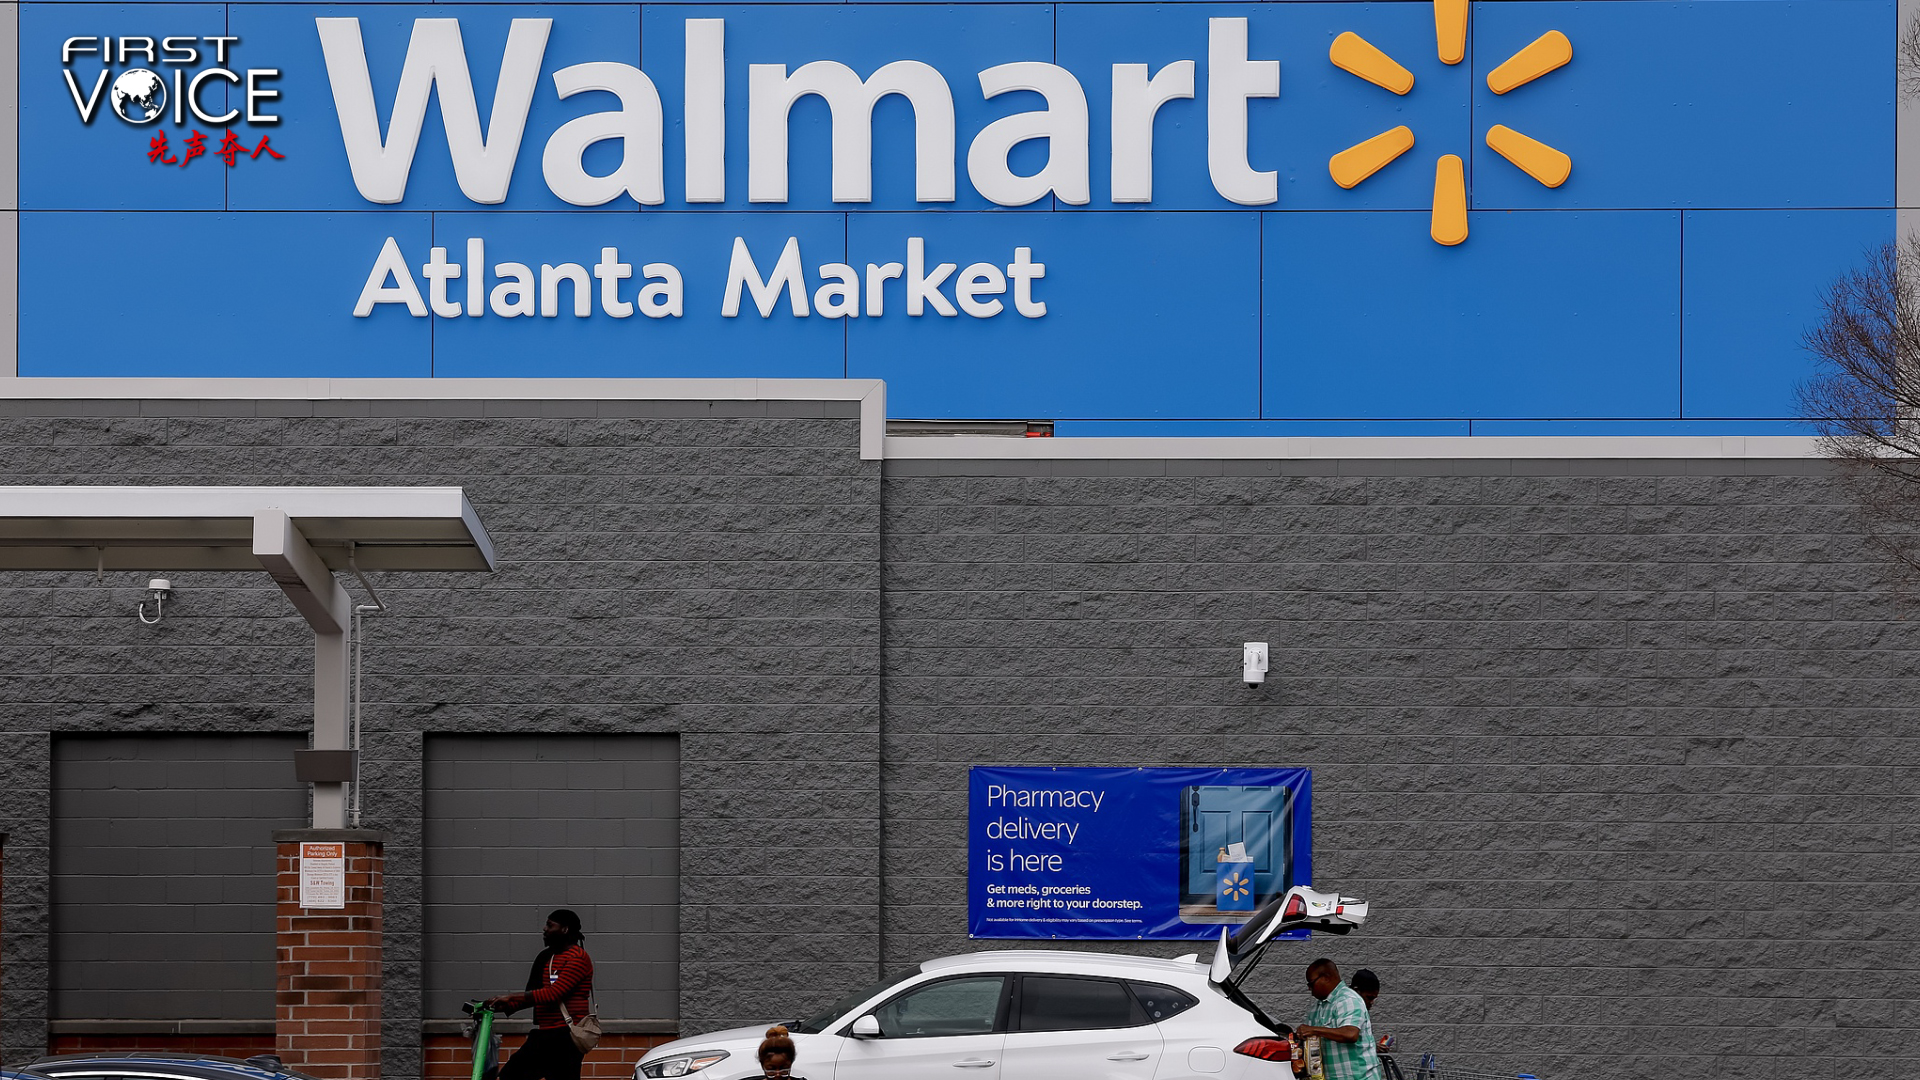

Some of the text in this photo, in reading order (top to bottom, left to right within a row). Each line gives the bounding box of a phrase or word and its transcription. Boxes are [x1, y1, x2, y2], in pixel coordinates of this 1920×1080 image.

[315, 16, 1281, 207] Walmart
[352, 236, 1047, 319] Atlanta Market
[987, 784, 1105, 813] Pharmacy
[986, 816, 1080, 845] delivery
[986, 848, 1063, 872] is here
[986, 884, 1091, 897] Get meds, groceries
[986, 897, 1144, 911] & more right to your doorstep.
